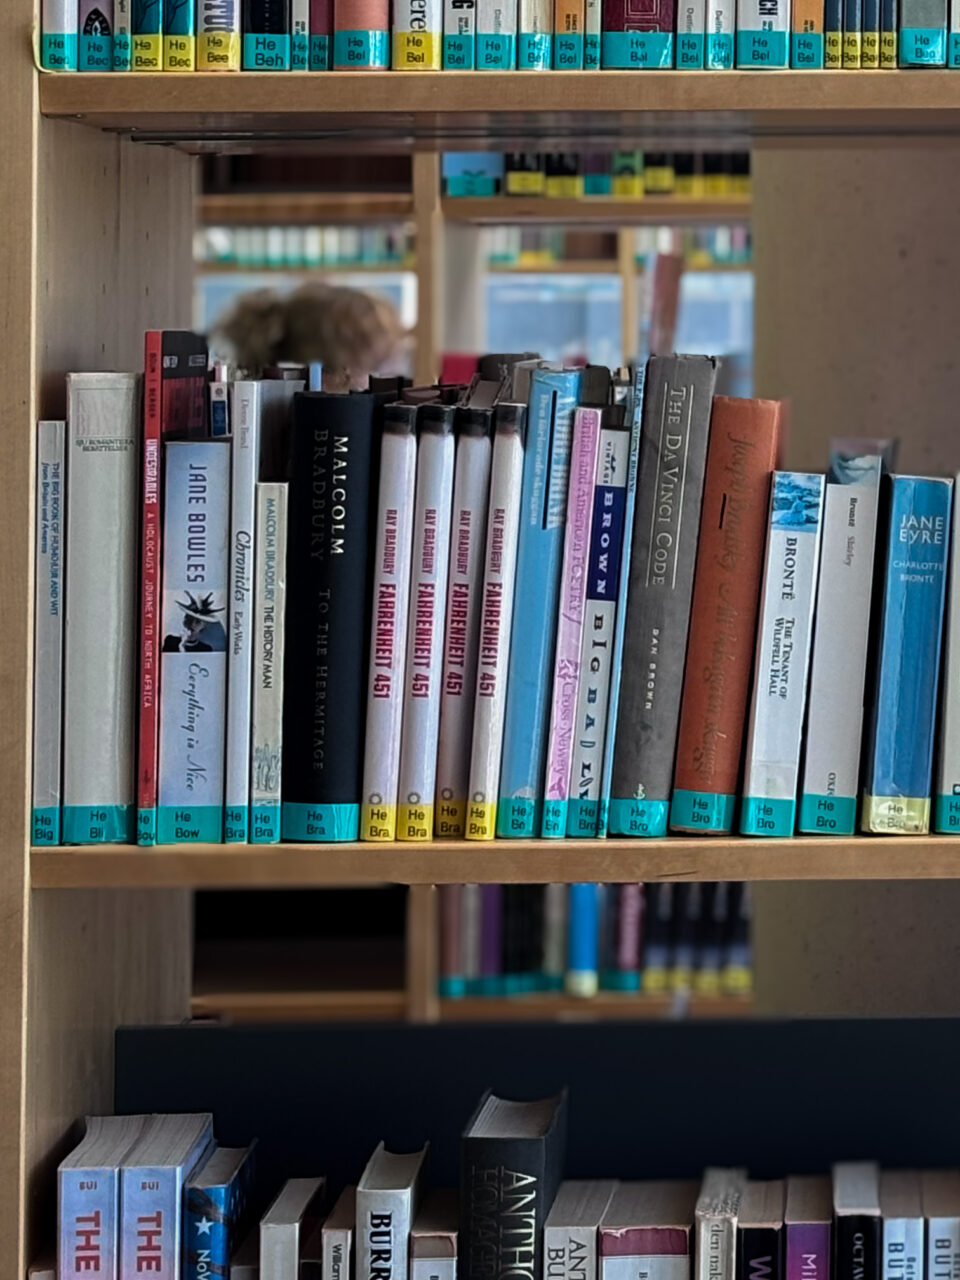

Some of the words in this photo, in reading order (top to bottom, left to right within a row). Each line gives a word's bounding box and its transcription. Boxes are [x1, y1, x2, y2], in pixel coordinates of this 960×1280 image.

[188, 464, 206, 505] JANE
[310, 430, 329, 561] BRADBURY
[330, 436, 348, 555] MALCOLM
[900, 514, 944, 531] JANE
[187, 513, 206, 583] BOWLES
[596, 493, 613, 594] BROWN
[234, 530, 251, 602] Chronicles
[263, 606, 273, 622] THE
[413, 583, 434, 669] FAHRENHEIT
[262, 625, 273, 662] HISTORY
[650, 629, 660, 654] DAN
[262, 666, 272, 688] MAN
[412, 674, 430, 697] 451
[645, 663, 656, 709] BROWN
[176, 811, 192, 822] He
[176, 828, 198, 839] Bow
[75, 1210, 101, 1272] THE
